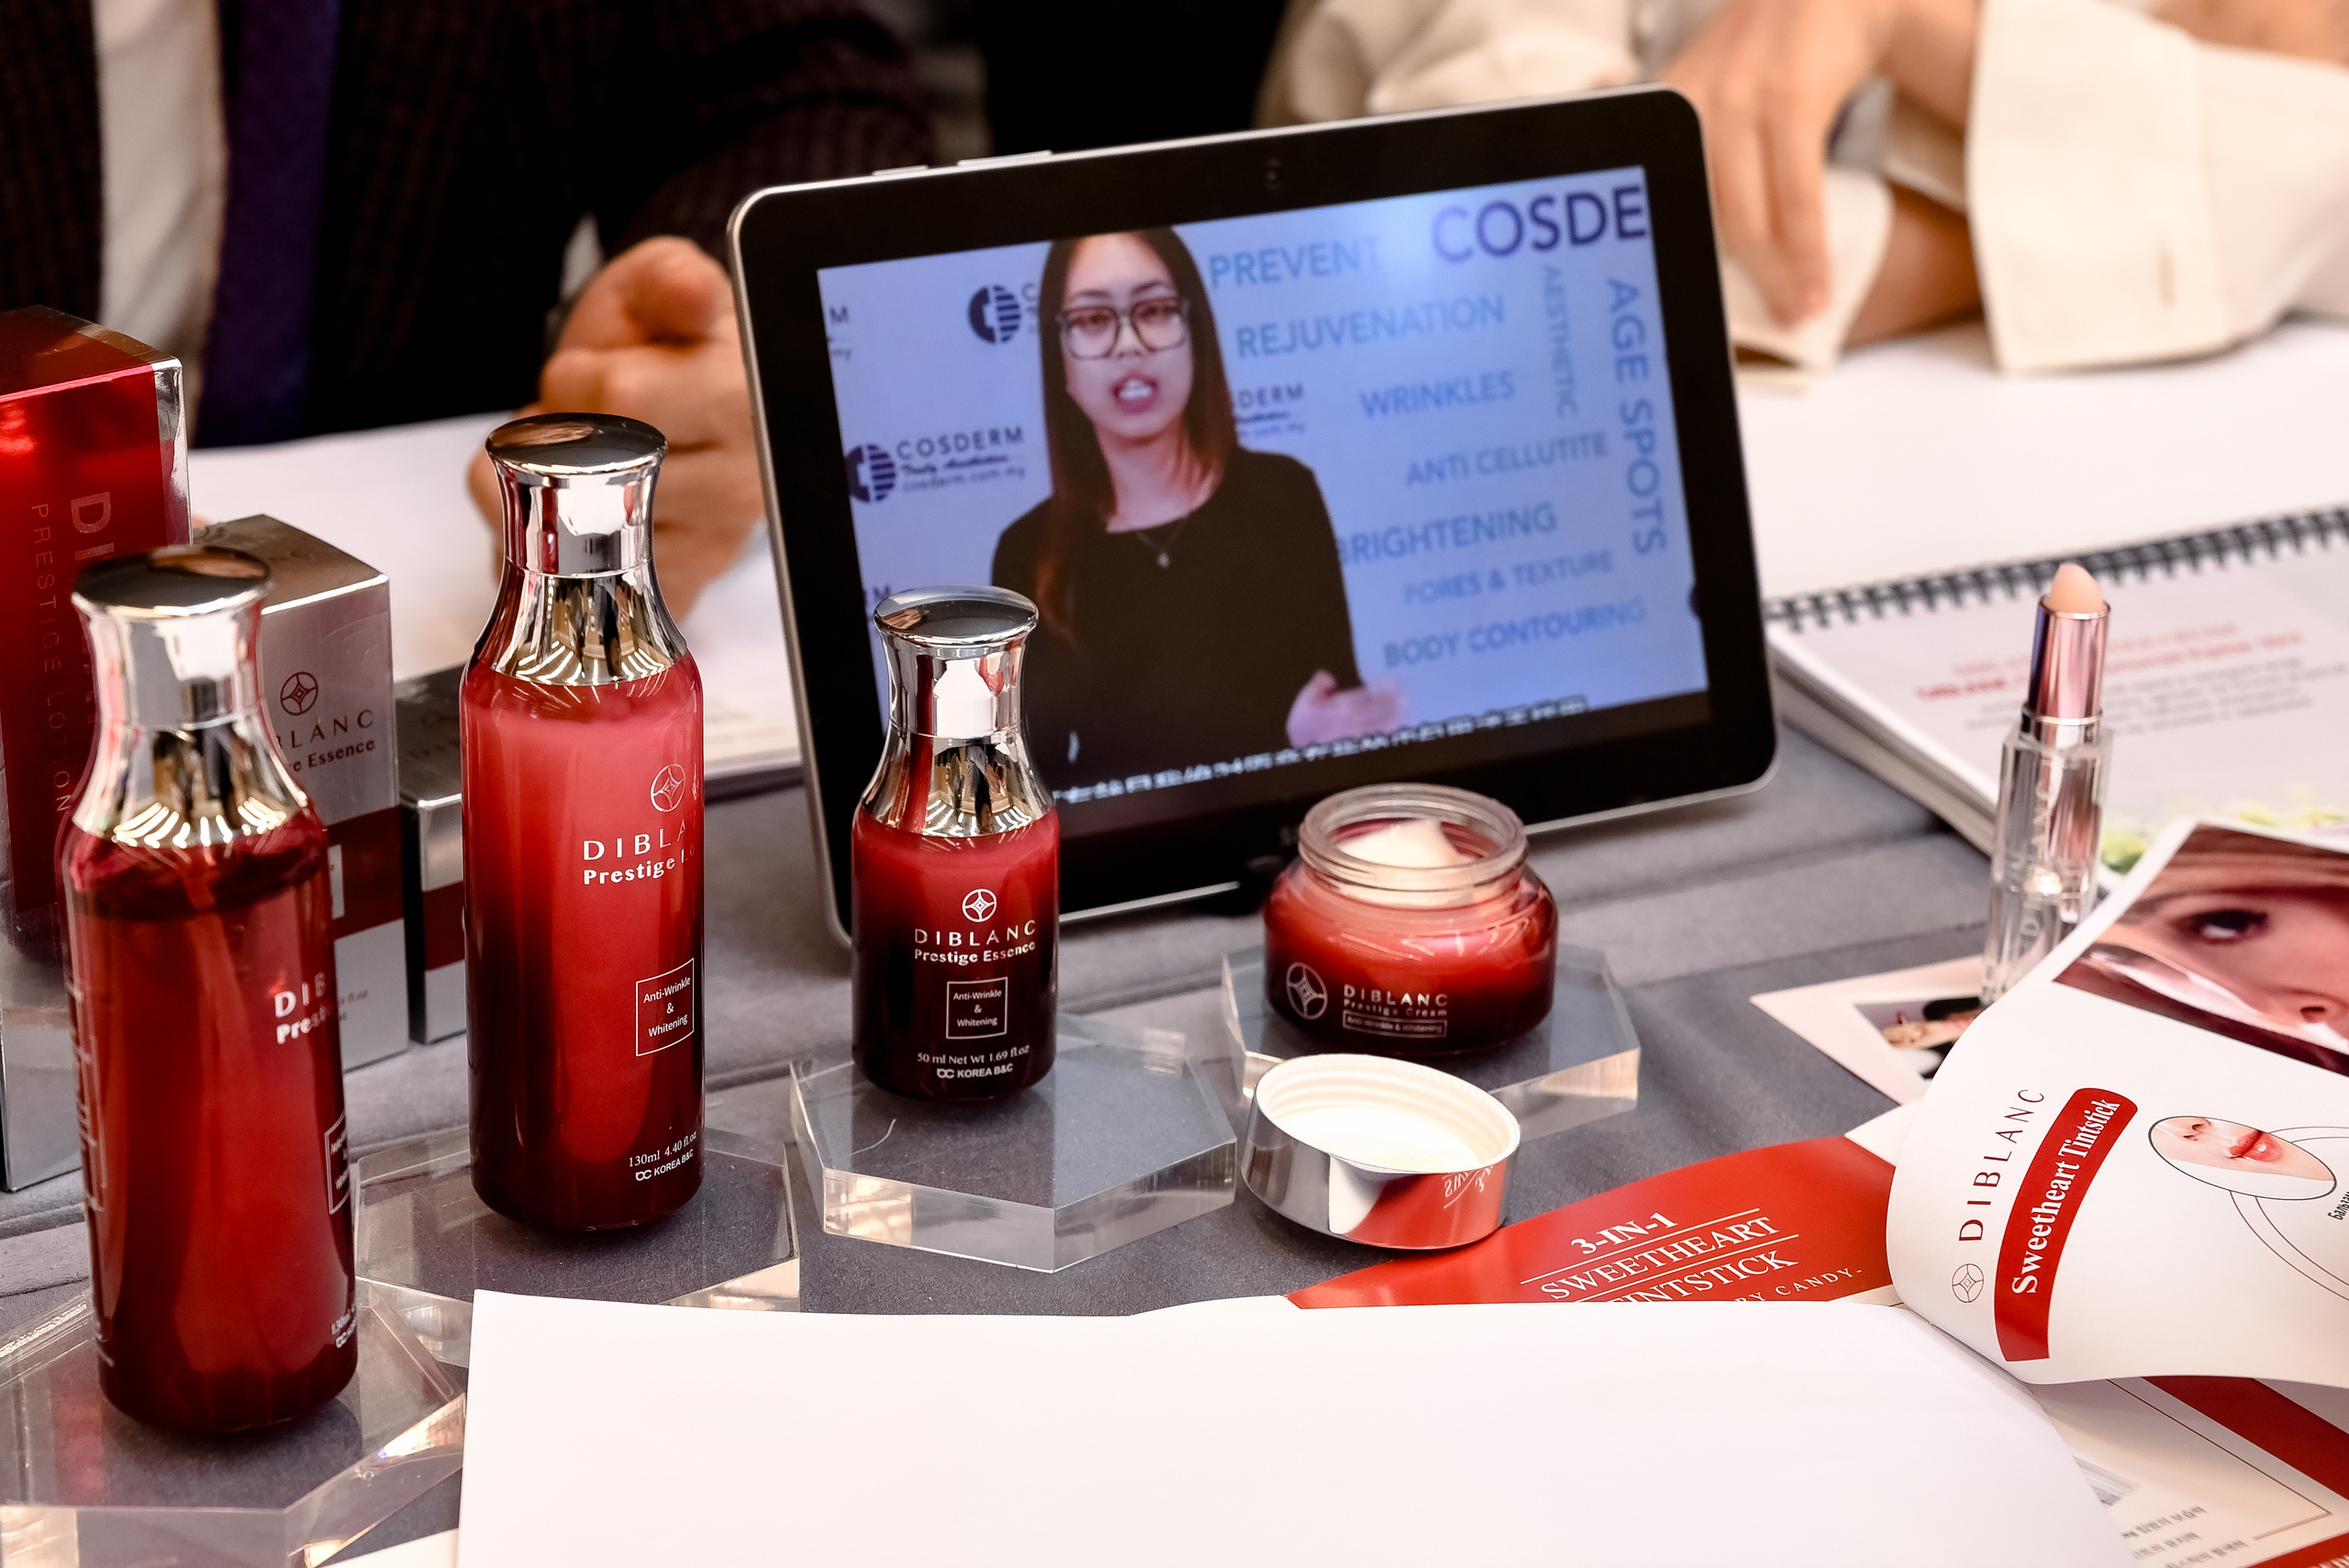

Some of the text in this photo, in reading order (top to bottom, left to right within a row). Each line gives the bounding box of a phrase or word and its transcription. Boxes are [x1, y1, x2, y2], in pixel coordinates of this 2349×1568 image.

[1431, 185, 1646, 263] COSDE
[1235, 294, 1504, 358] REJUVENATION
[1237, 382, 1304, 409] DERM
[1359, 370, 1516, 418] WRINKLES
[1608, 277, 1667, 555] AGE SPOTS
[896, 426, 1023, 460] COSDERM
[1406, 453, 1469, 486] ANTI
[1512, 550, 1612, 586] TEXTURE
[1383, 598, 1647, 668] BODY CONTOURING
[276, 709, 373, 750] LANC
[308, 740, 375, 768] Essence
[583, 818, 686, 861] DIBLA
[584, 858, 675, 885] Prestige
[914, 919, 1035, 947] DIBLANC
[914, 940, 1036, 966] Prestige Essence
[643, 976, 691, 1004] Anti-Wrinkle
[952, 989, 1003, 1001] Anti-Wrinkle
[1343, 984, 1448, 1007] DIBLANC
[666, 1002, 674, 1014] &
[957, 1016, 998, 1027] Whitening
[974, 1004, 982, 1014] &
[648, 1014, 688, 1038] Whitening
[917, 1052, 930, 1063] 50
[932, 1054, 946, 1064] ml
[948, 1055, 968, 1065] Net
[970, 1054, 985, 1064] Wt
[989, 1050, 1008, 1062] 1.69
[957, 1068, 993, 1079] KOREA
[994, 1062, 1014, 1075] B&C
[629, 1150, 661, 1168] 130ml
[664, 1140, 683, 1157] 4.40
[653, 1158, 682, 1176] KOREA
[681, 1149, 694, 1164] B&C
[1958, 1089, 2044, 1241] DIBLANC
[2011, 1099, 2121, 1295] Sweetheart Tintstick
[1571, 1212, 1678, 1255] 3-IN-1
[1541, 1217, 1780, 1300] SWEETHEART
